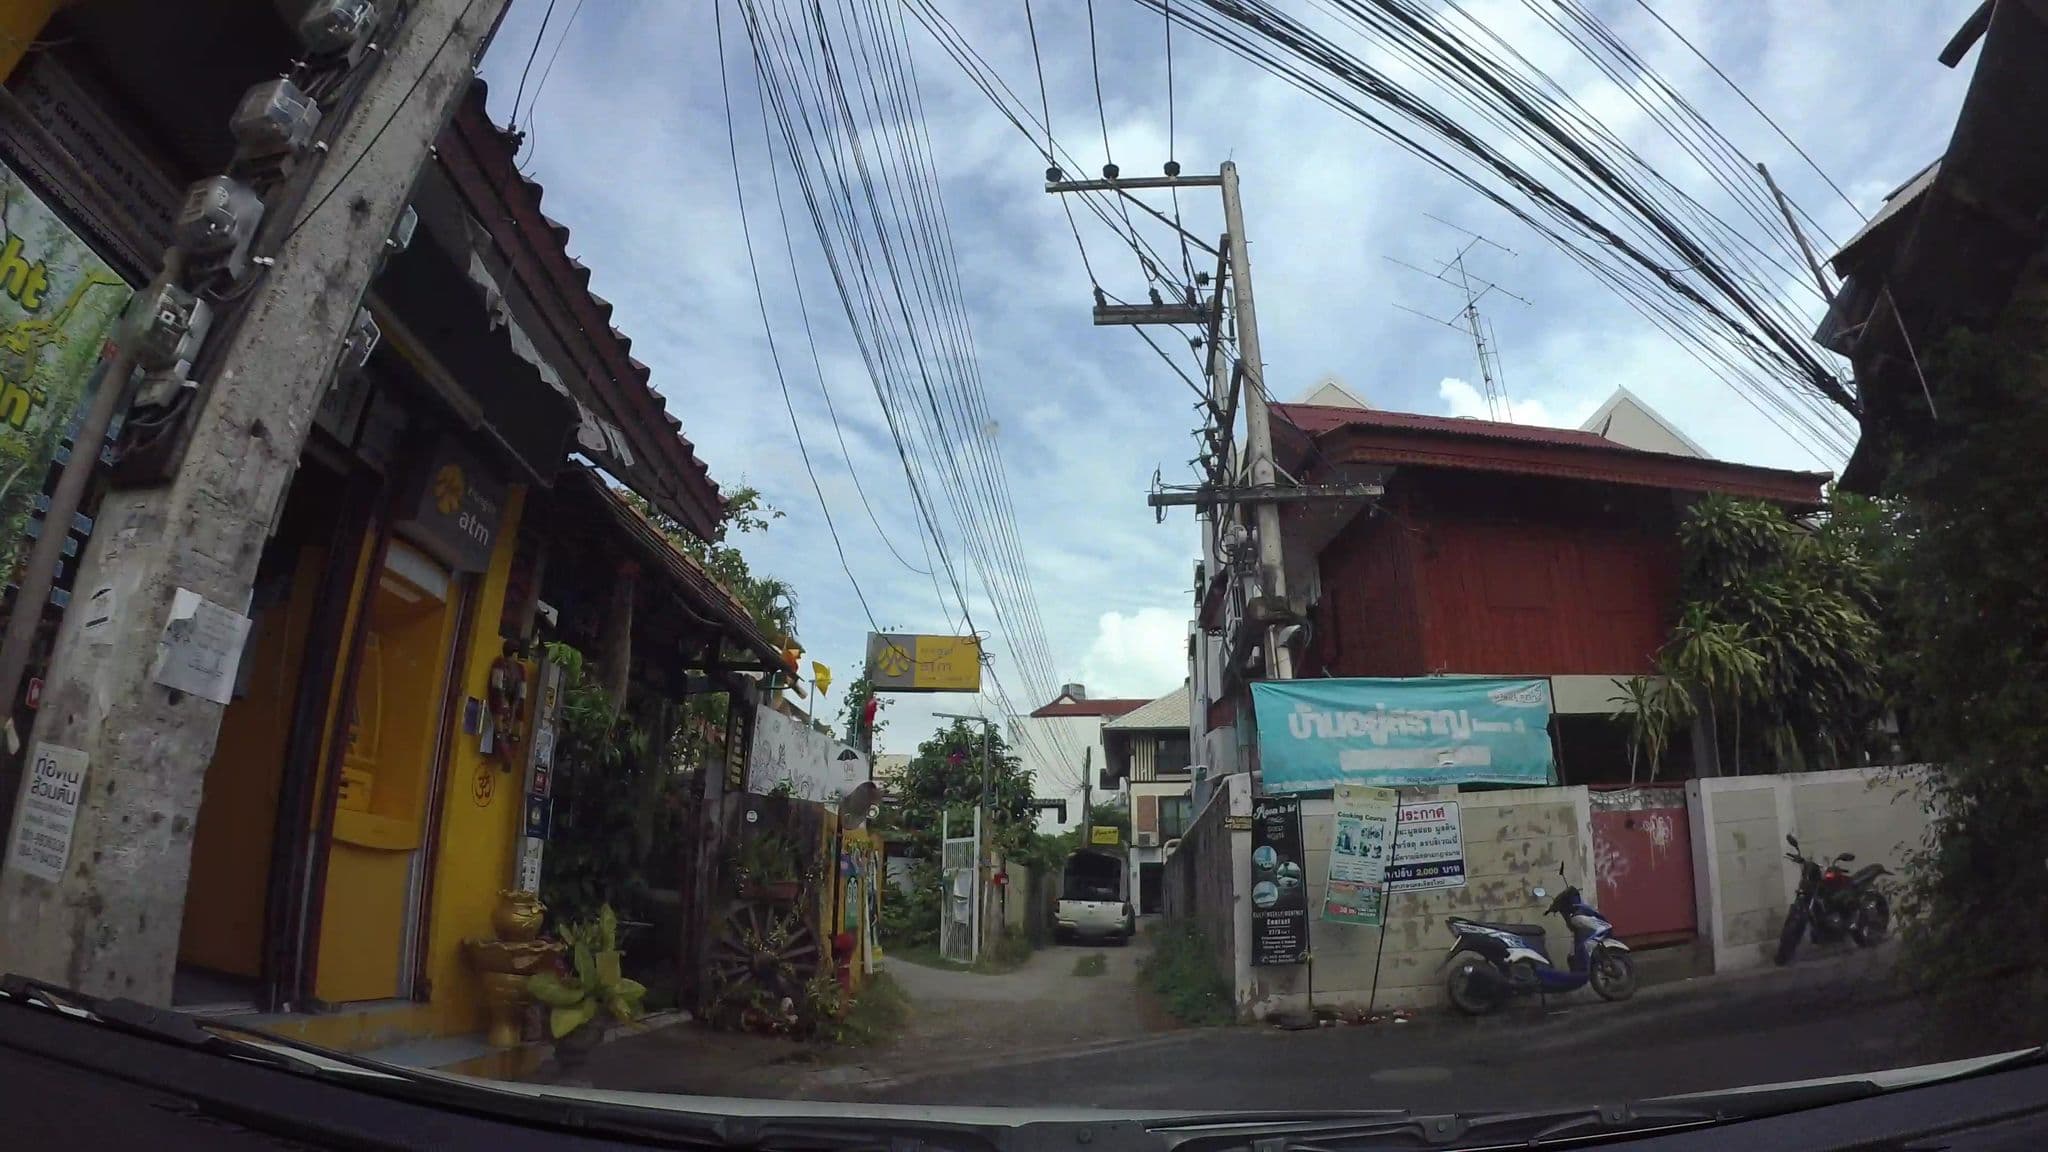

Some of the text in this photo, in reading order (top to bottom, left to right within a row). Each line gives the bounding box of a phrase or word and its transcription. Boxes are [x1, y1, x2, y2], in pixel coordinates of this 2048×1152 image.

[0, 233, 47, 312] ht
[458, 511, 489, 546] atm
[1337, 811, 1363, 820] Cooking
[1416, 868, 1439, 877] 2,000
[1442, 865, 1460, 874] บาท
